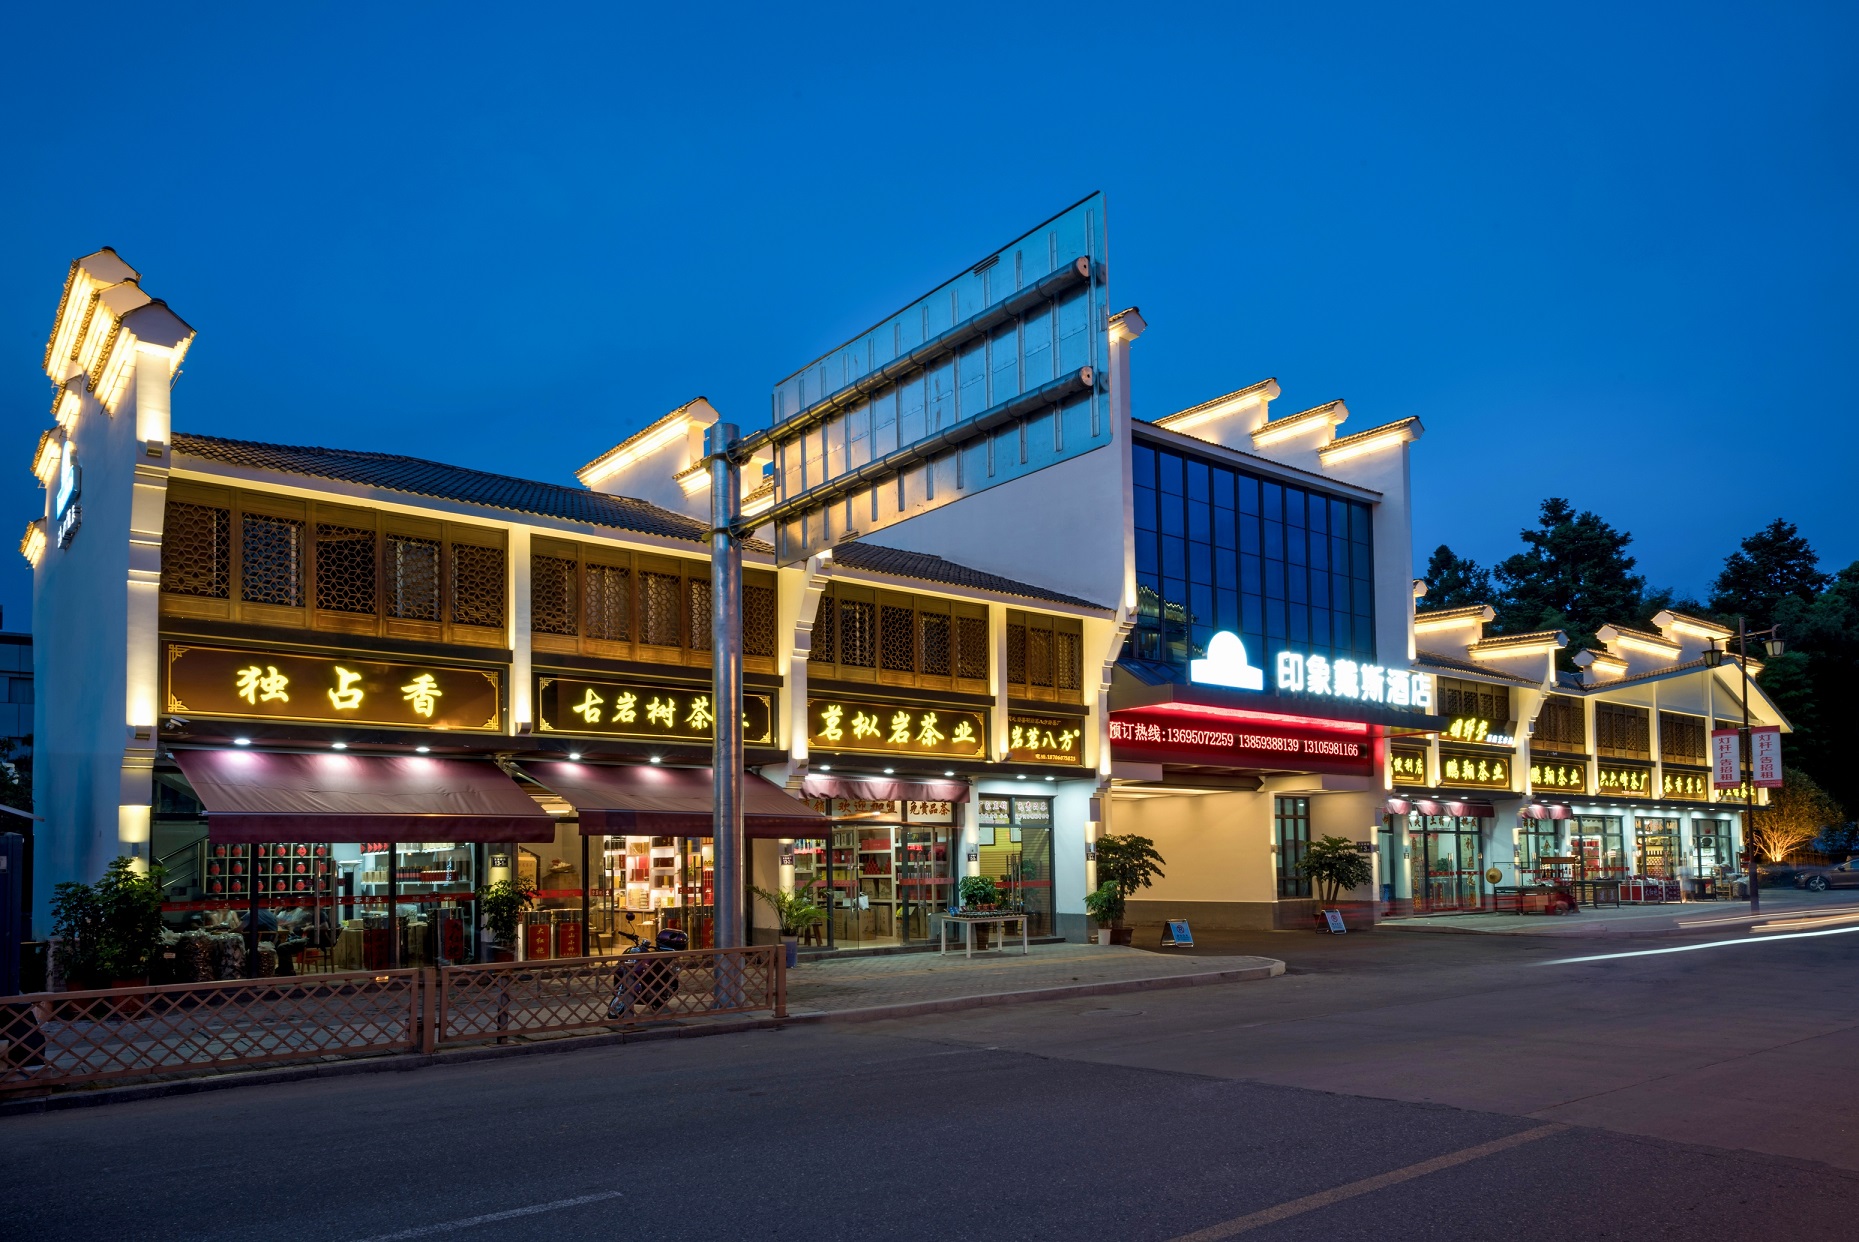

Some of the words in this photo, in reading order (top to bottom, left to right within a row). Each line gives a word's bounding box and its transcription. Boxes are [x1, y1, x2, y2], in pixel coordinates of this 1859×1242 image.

[236, 665, 442, 718] 独占香
[1277, 651, 1431, 707] 印象戴斯酒店
[573, 688, 750, 730] 古岩树茶
[1239, 734, 1299, 752] 13859388139
[1303, 740, 1359, 756] 13105981166
[1389, 753, 1422, 776] 便利店
[1718, 736, 1733, 781] 灯杆广告招租
[1759, 733, 1774, 779] 灯杆广告招租
[1446, 758, 1504, 781] 鹏翔茶业
